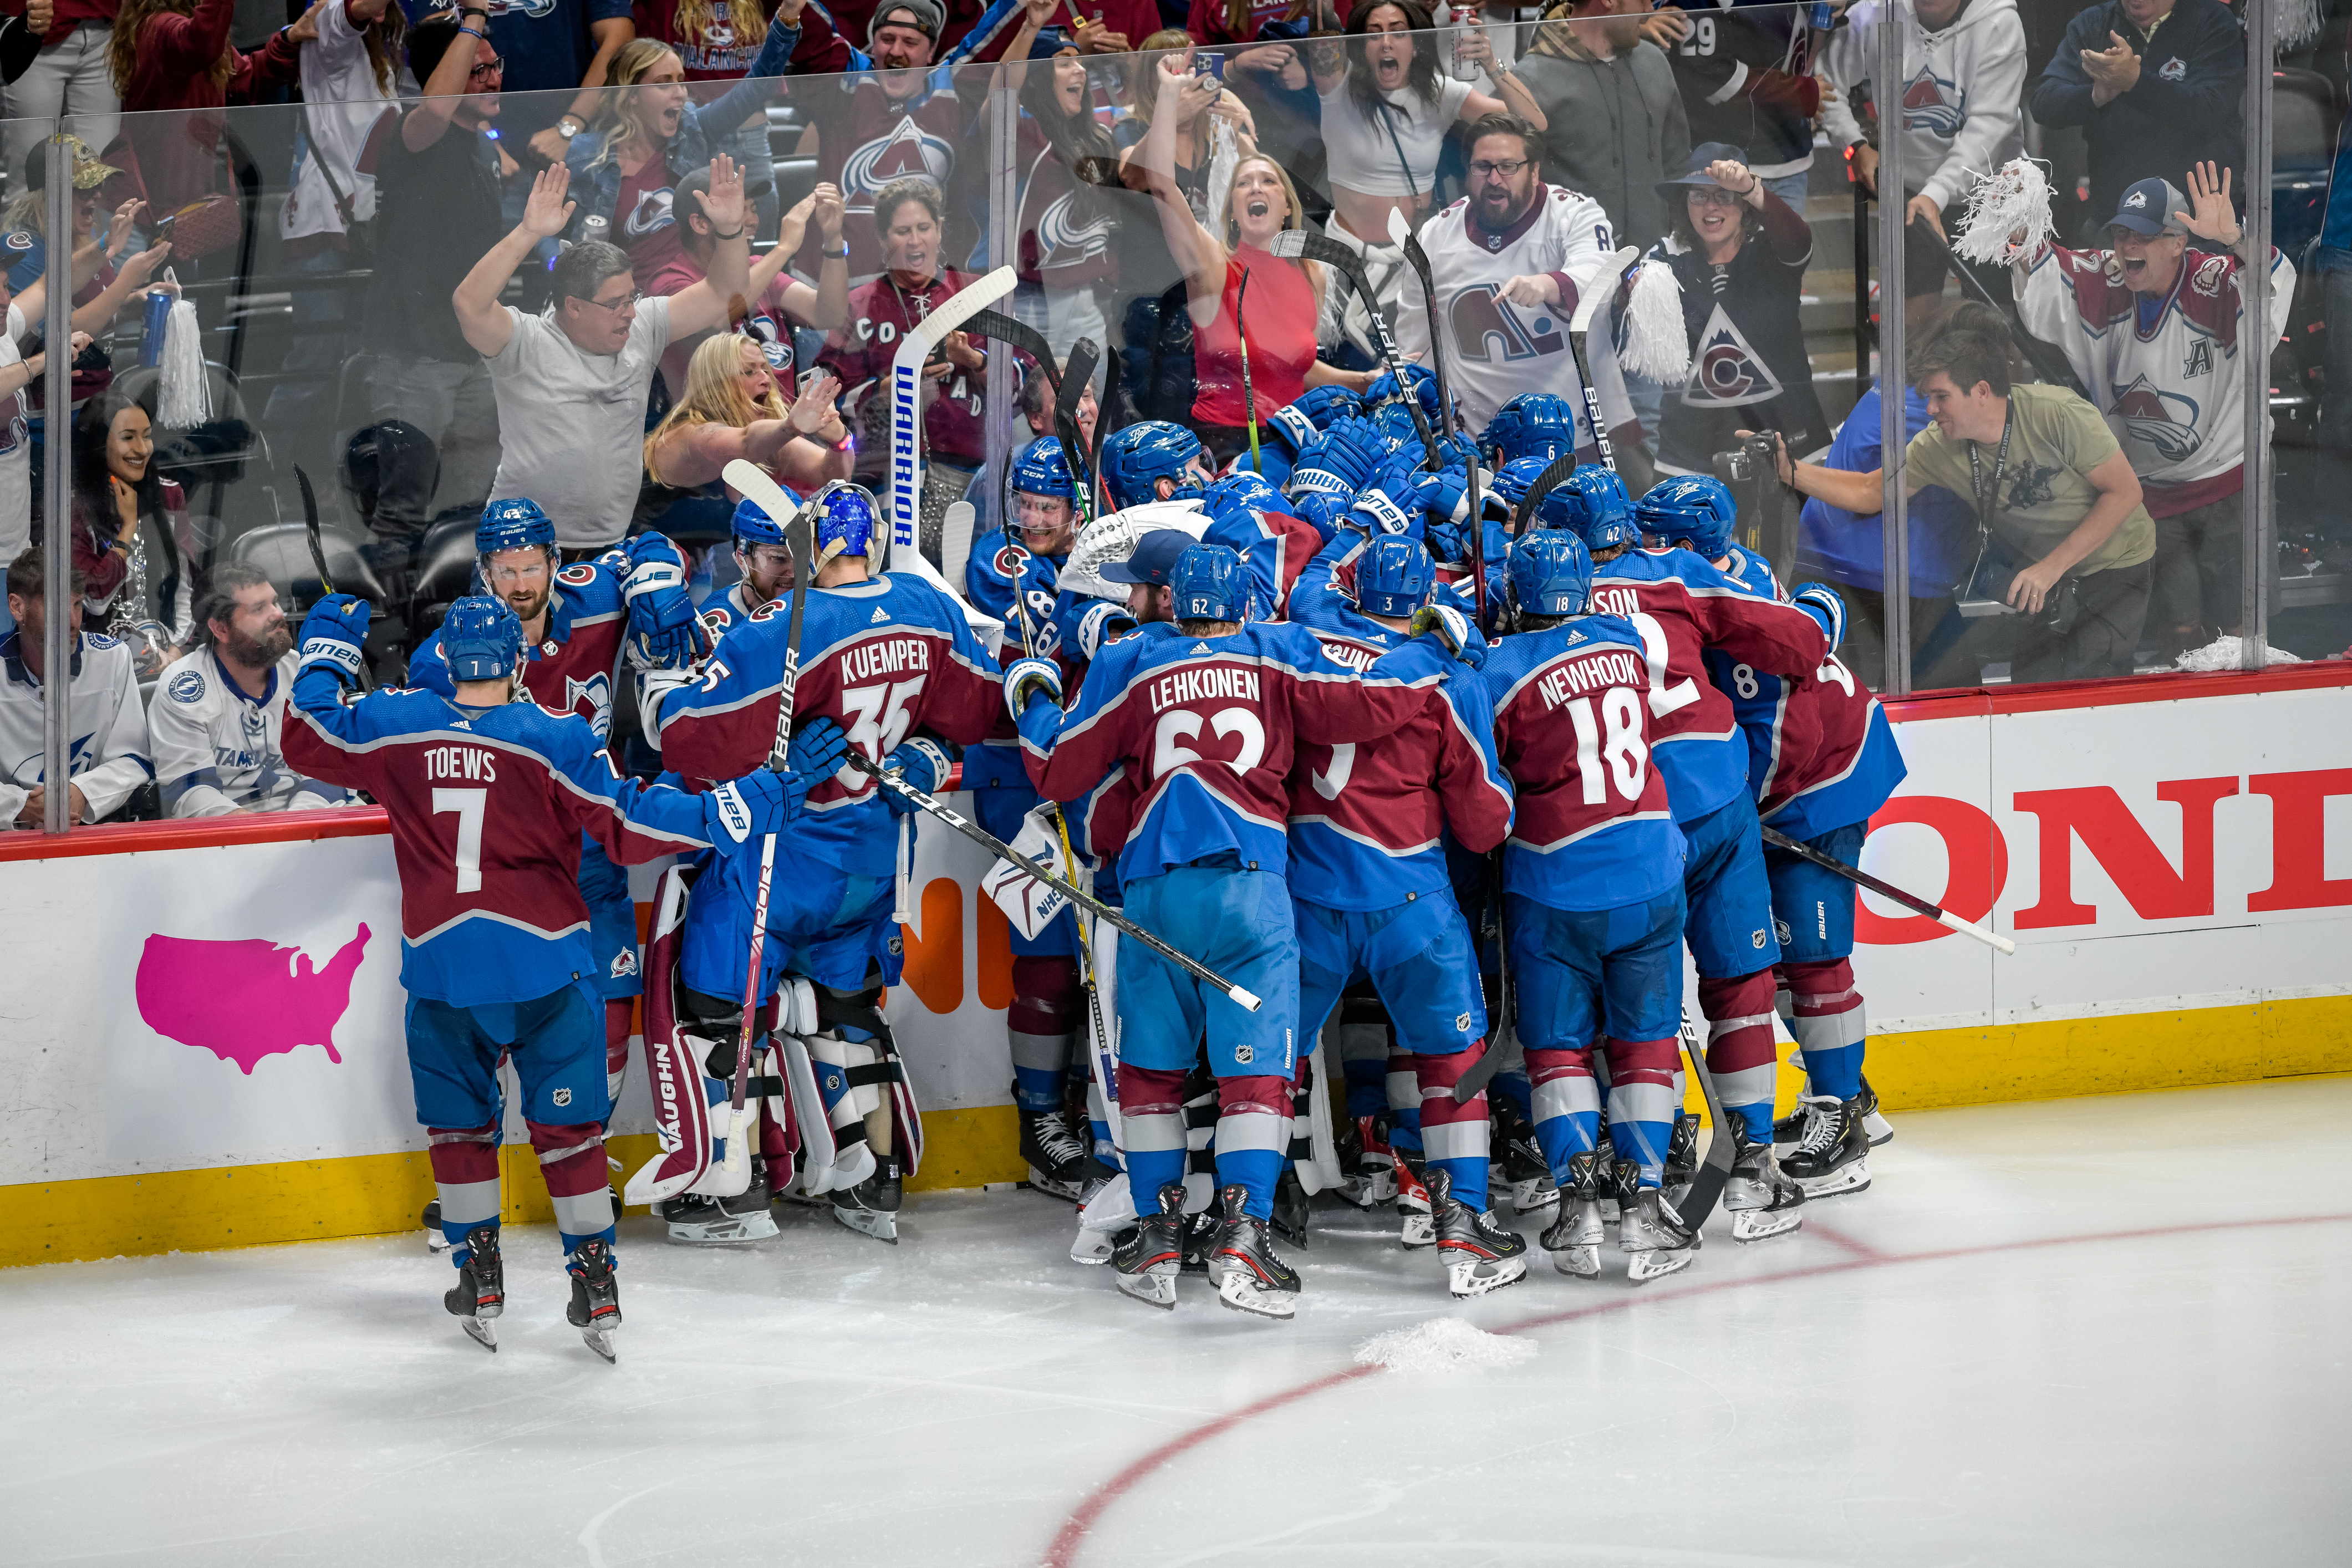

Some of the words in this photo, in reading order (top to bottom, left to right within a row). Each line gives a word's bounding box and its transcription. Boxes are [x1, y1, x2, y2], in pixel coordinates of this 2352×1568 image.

[1681, 17, 1716, 56] 29
[1371, 312, 1418, 404] BAUER
[1129, 425, 1153, 445] Ball
[1583, 387, 1616, 472] BAUER
[2003, 423, 2011, 446] STANLEY
[894, 364, 914, 547] WARRIOR
[1547, 445, 1555, 460] 6
[1021, 469, 1046, 479] CCM
[1494, 477, 1512, 486] CCM
[1250, 483, 1273, 496] Ball
[1675, 482, 1701, 501] Ball
[500, 527, 526, 536] BAUER
[1606, 526, 1620, 542] 42
[1192, 598, 1208, 614] 62
[1385, 597, 1392, 611] 3
[1555, 597, 1569, 612] 18
[1594, 588, 1641, 614] SON
[870, 614, 891, 624] adidas
[1566, 635, 1589, 646] adidas
[471, 660, 478, 676] 7
[701, 654, 733, 694] 5
[841, 639, 929, 686] KUEMPER
[1626, 612, 1701, 720] 2
[169, 673, 184, 689] TAMPA
[189, 675, 205, 702] LIGHTNING
[1149, 668, 1260, 715] LEHKONEN
[1537, 653, 1640, 711] NEWHOOK
[1732, 663, 1759, 699] 8
[774, 647, 800, 761] BAUER
[449, 722, 472, 731] adidas
[836, 673, 928, 791] 35
[1153, 707, 1265, 781] 62
[1564, 686, 1648, 805] 18
[424, 746, 496, 783] TOEWS
[431, 787, 487, 894] 7
[1855, 767, 2352, 945] OND
[1817, 900, 1826, 940] BAUER
[741, 1026, 750, 1063] HYPERLITE
[1239, 1050, 1250, 1060] NHL
[557, 1091, 569, 1102] NHL
[654, 1043, 684, 1154] VAUGHN
[1780, 1188, 1794, 1200] UER
[1638, 1219, 1677, 1248] VAPOR
[1663, 1226, 1683, 1241] BAUER
